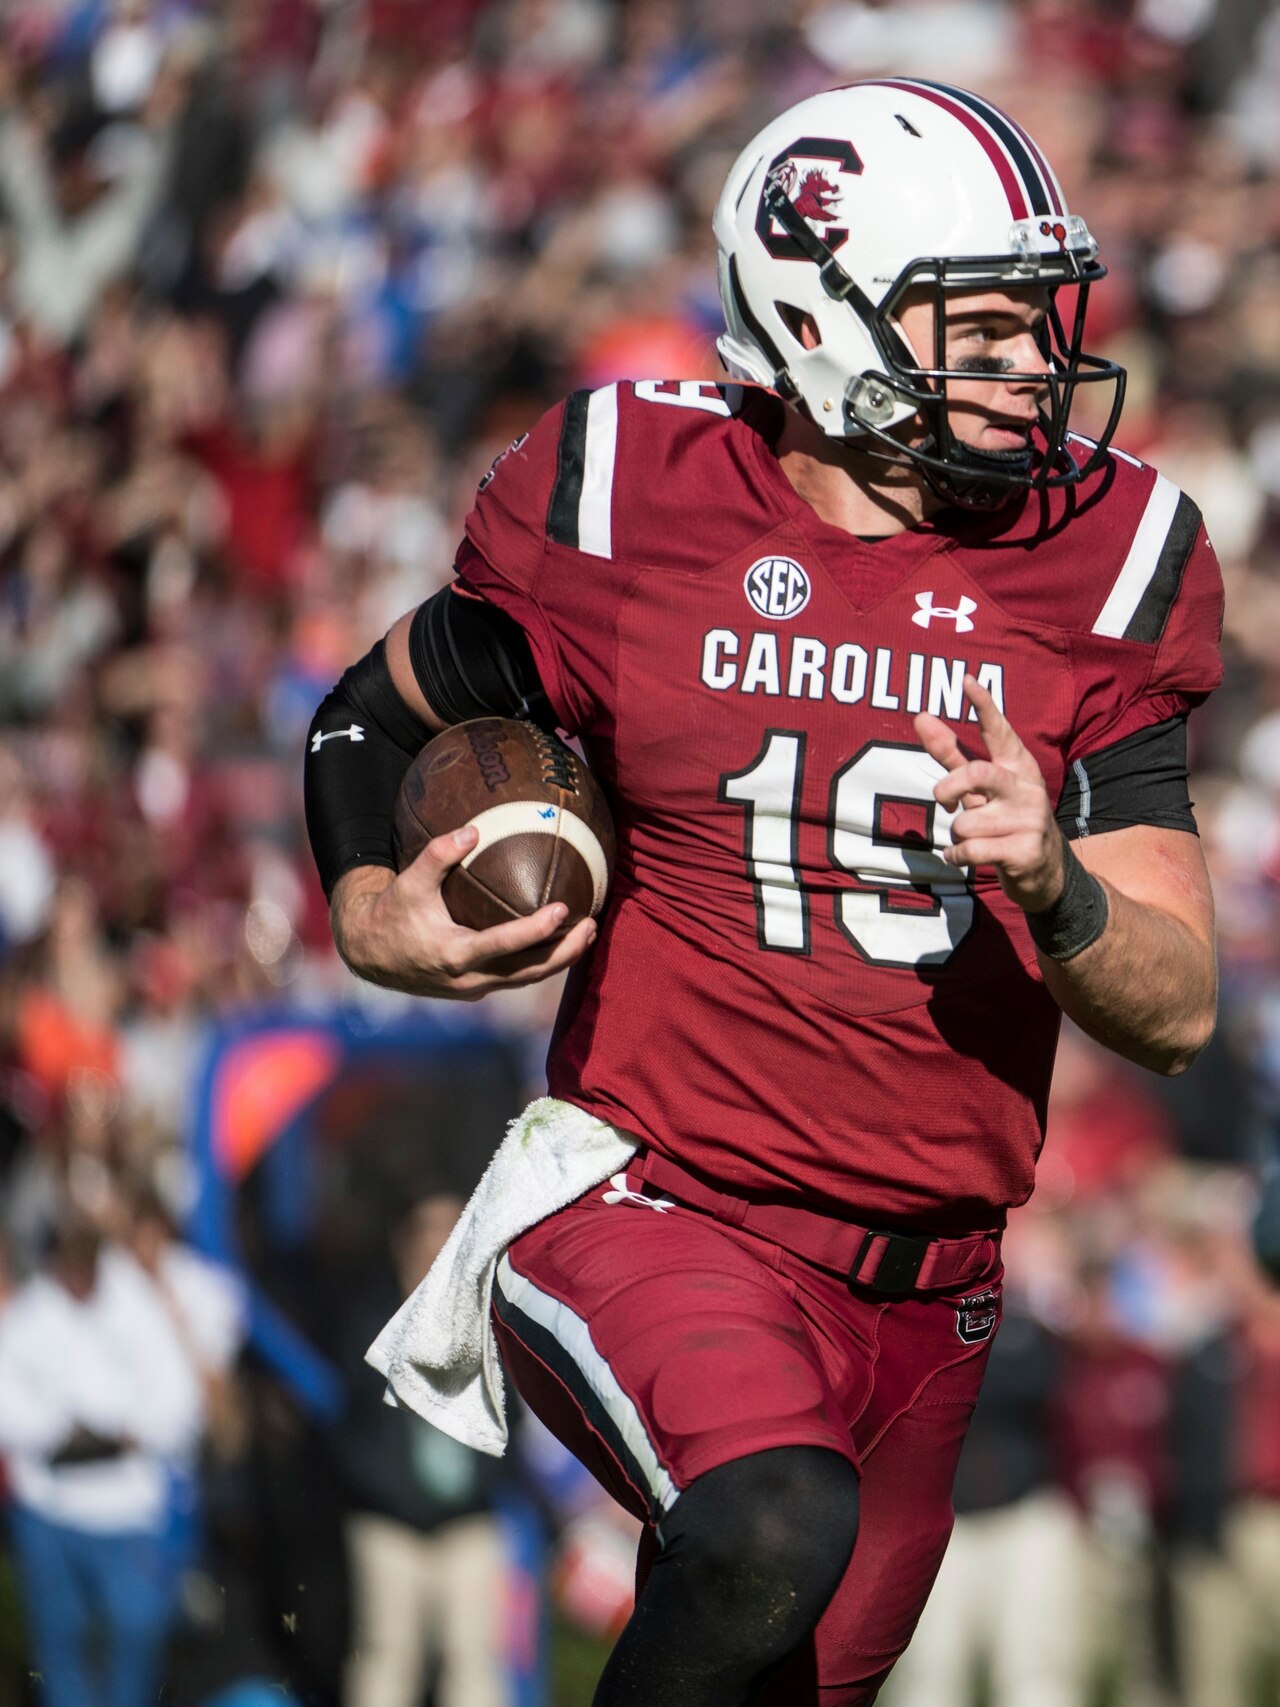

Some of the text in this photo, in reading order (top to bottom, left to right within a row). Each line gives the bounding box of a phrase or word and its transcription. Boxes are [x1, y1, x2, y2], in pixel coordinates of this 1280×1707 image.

[750, 560, 804, 615] SEC
[700, 628, 1005, 723] CAROLINA
[717, 728, 978, 970] 19
